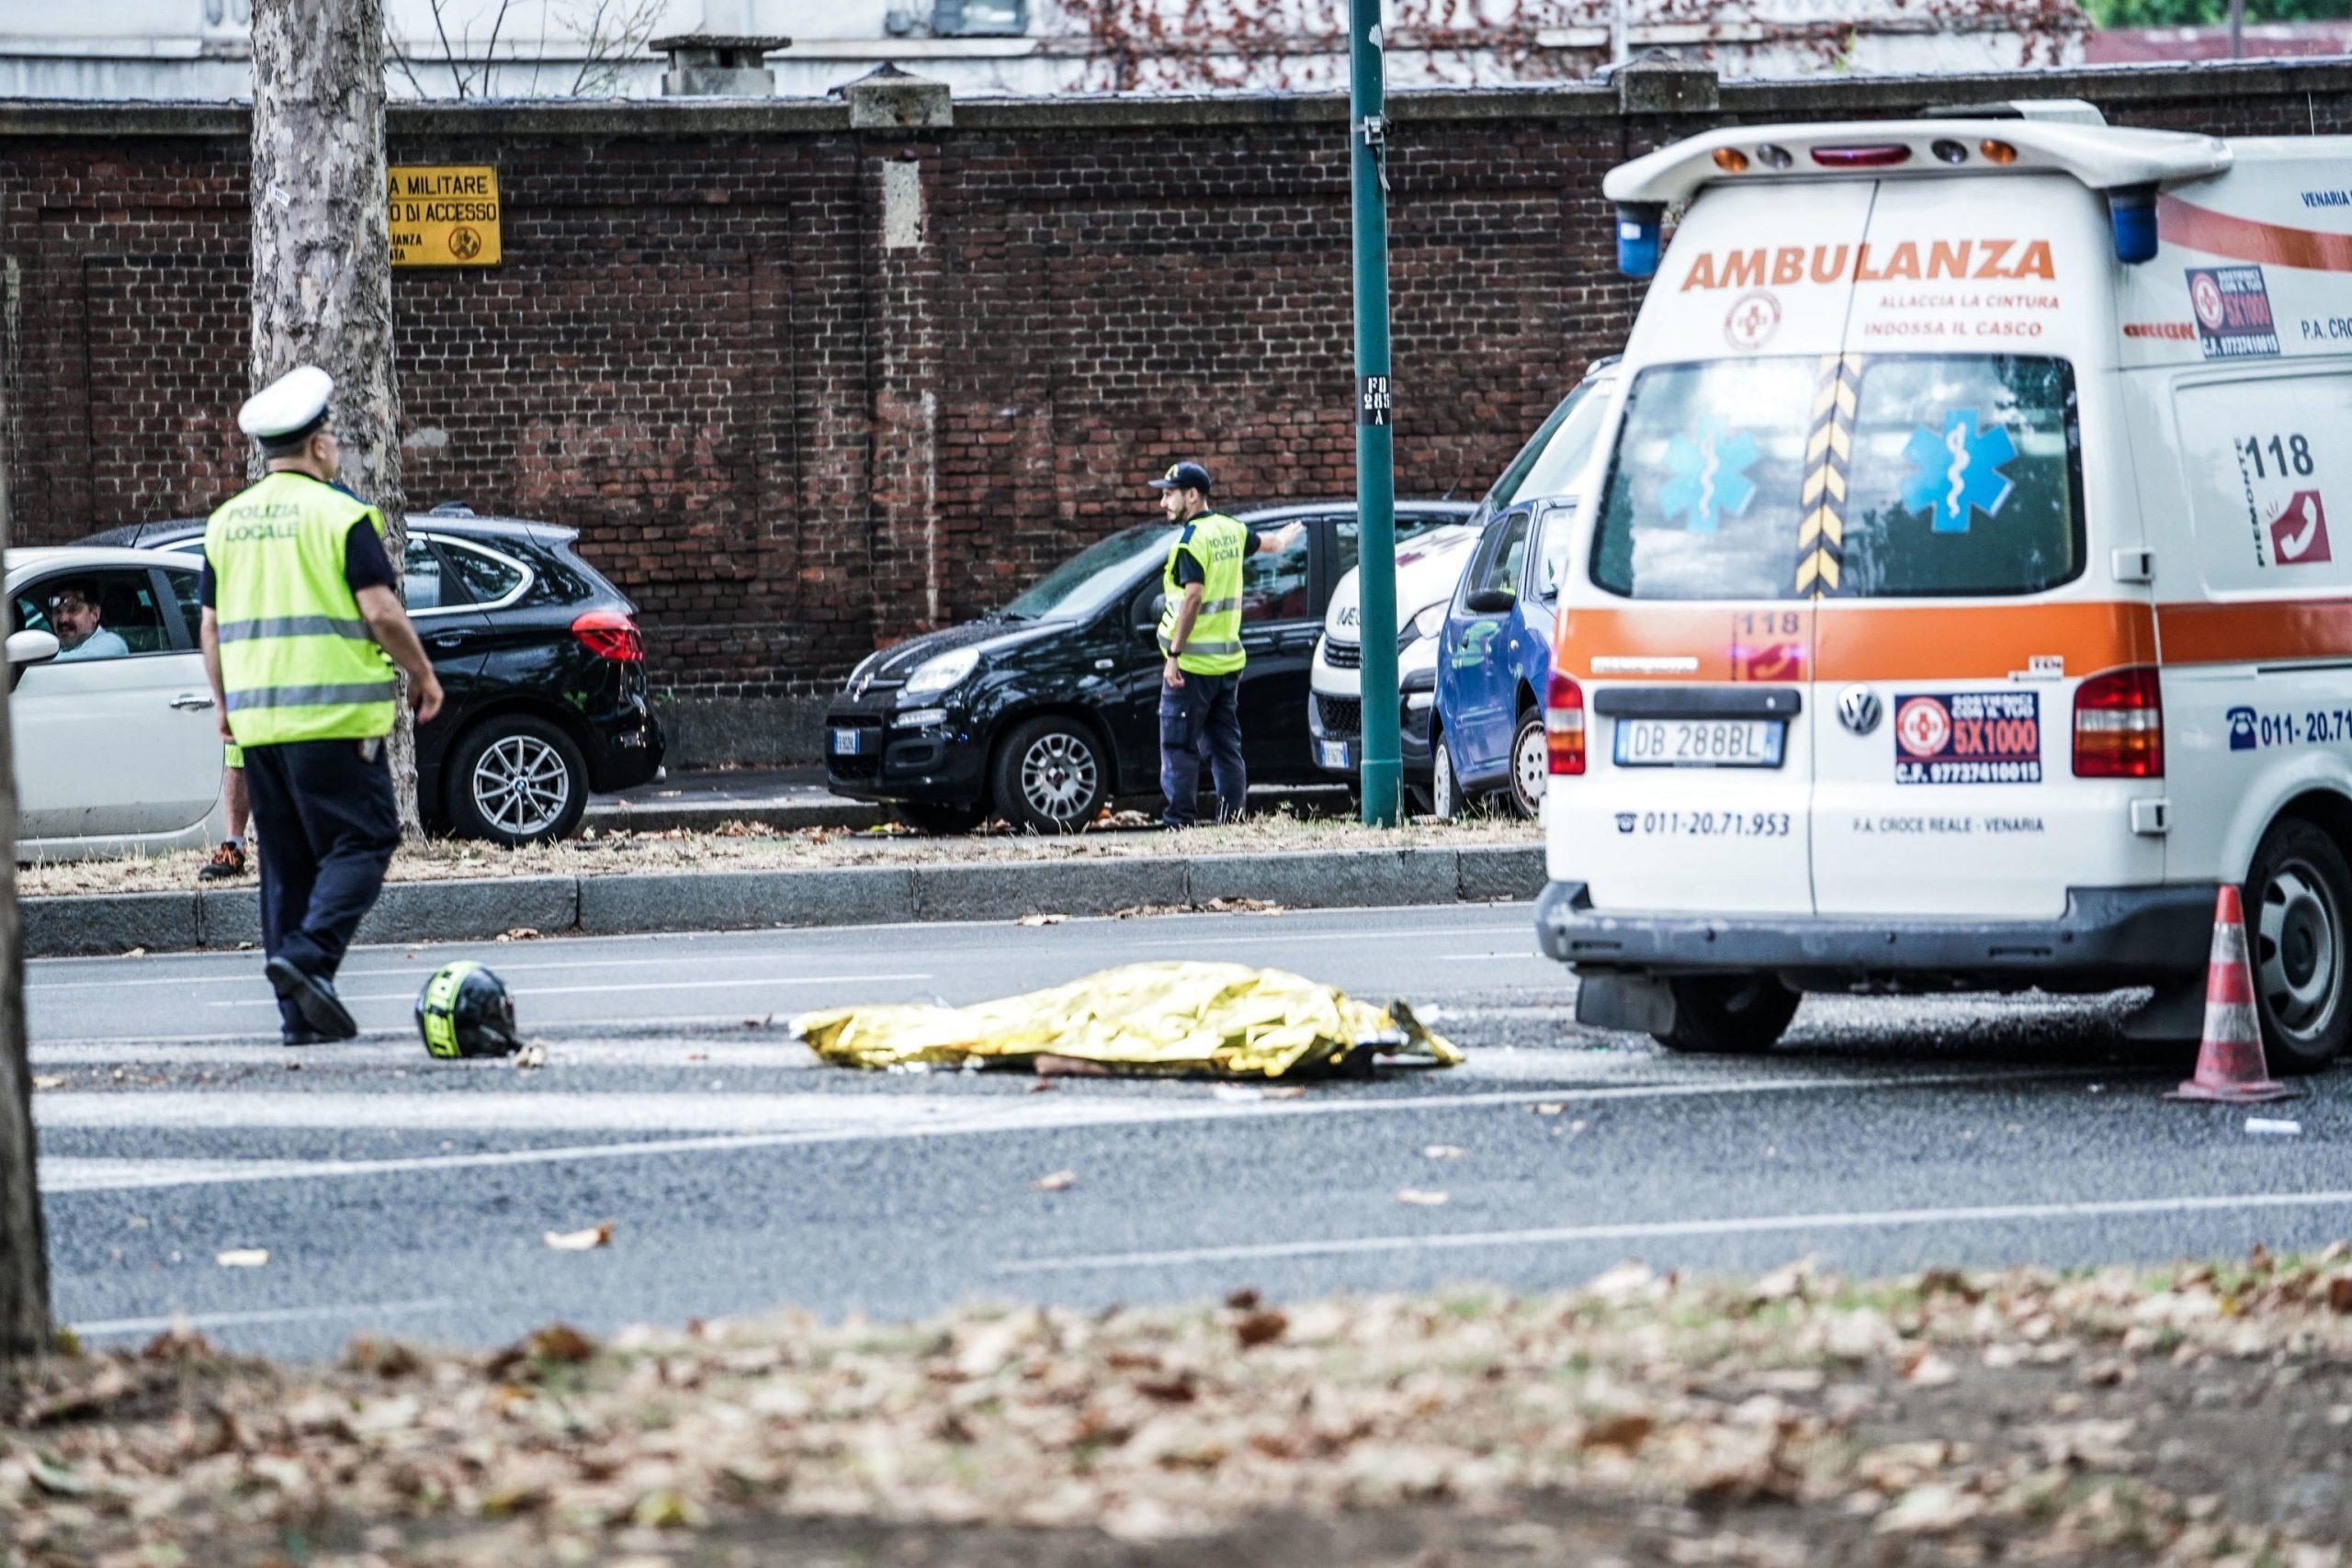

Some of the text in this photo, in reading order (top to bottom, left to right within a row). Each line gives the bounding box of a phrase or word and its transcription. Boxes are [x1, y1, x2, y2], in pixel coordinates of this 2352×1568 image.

[407, 175, 489, 195] MILITARE
[2300, 190, 2350, 208] VENARIA
[406, 203, 421, 221] DI
[425, 202, 497, 221] ACCESSO
[1679, 239, 2056, 292] AMBULANZA
[1879, 294, 2060, 310] ALLACCIA LA CINTURA
[1863, 321, 2042, 337] INDOSSA IL CASCO
[2301, 319, 2327, 340] P.A.
[2245, 433, 2314, 479] 118
[227, 503, 300, 521] POLIZIA
[225, 522, 300, 543] LOCALE
[1743, 612, 1799, 636] 118
[1634, 724, 1759, 757] DB 288BL
[1953, 718, 2037, 755] 5X1000
[1896, 762, 1928, 783] C.F.
[1644, 810, 1791, 837] 011-20.71.953
[1880, 817, 1925, 833] CROCE
[1930, 817, 1972, 833] REALE
[1984, 816, 2044, 834] VENARIA
